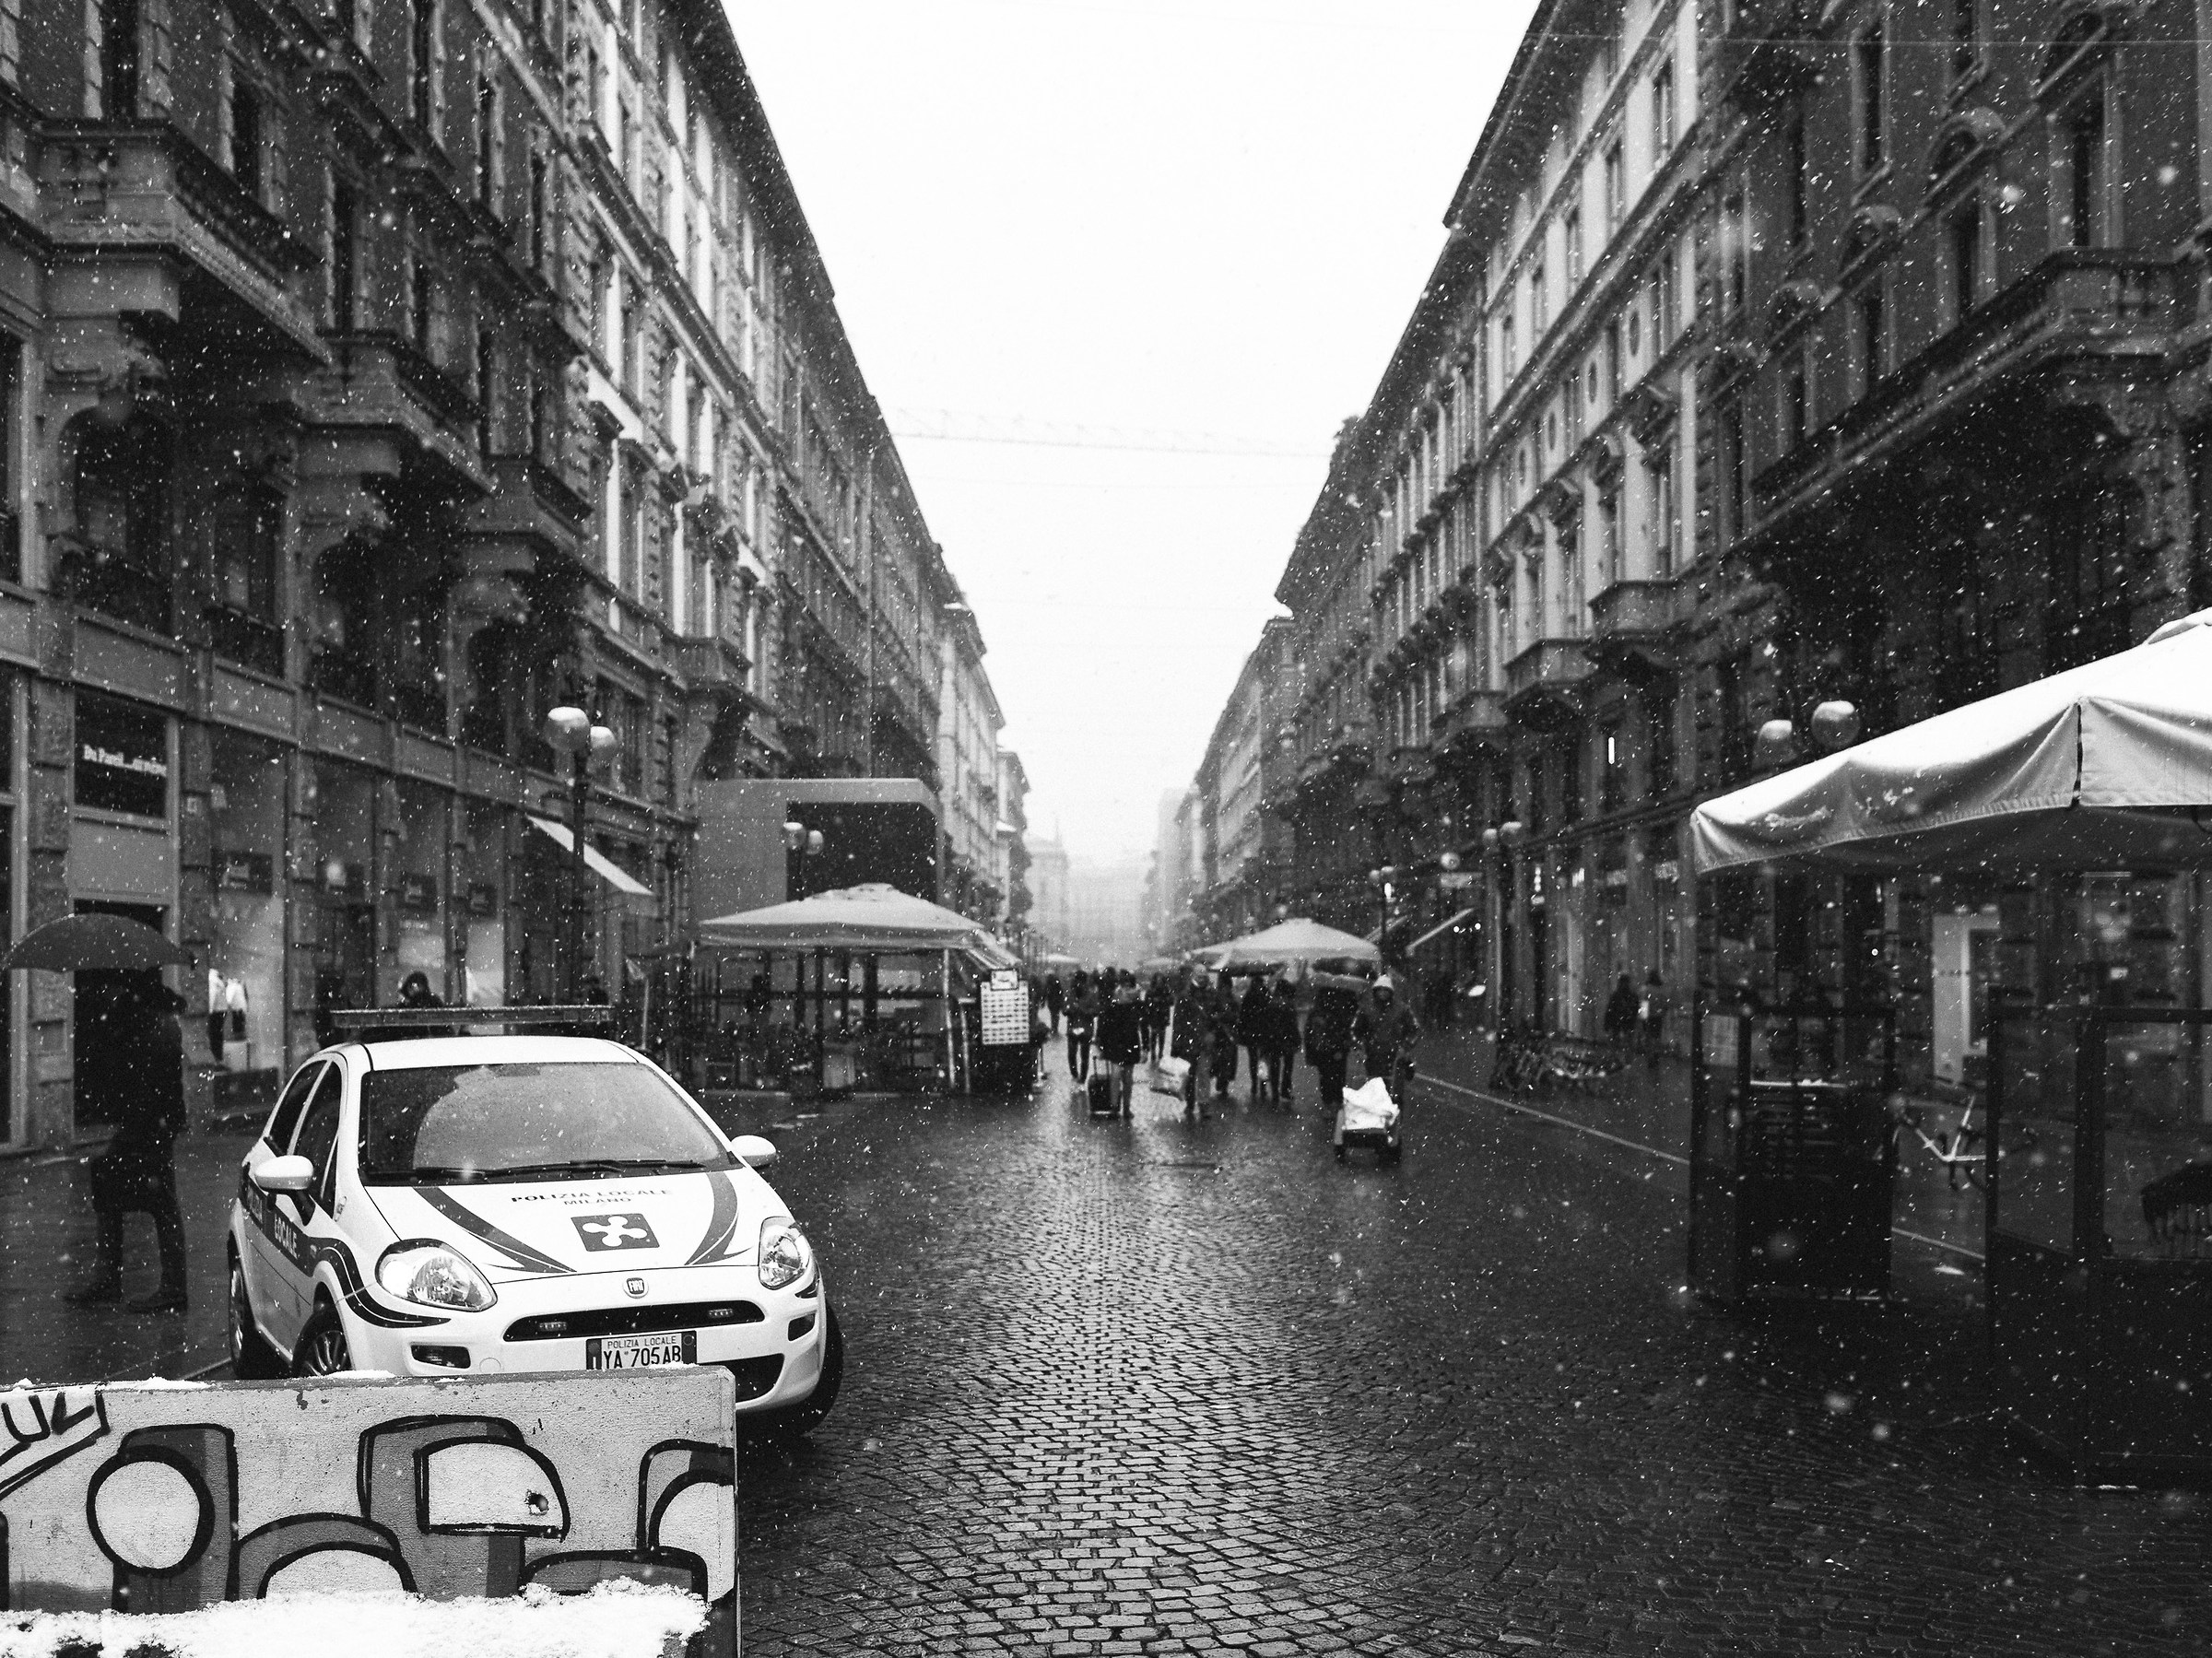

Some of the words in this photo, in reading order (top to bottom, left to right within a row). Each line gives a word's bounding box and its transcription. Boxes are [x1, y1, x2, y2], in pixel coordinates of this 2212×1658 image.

[511, 1193, 591, 1202] POLIZIA
[597, 1189, 674, 1197] LOCALE
[564, 1197, 631, 1205] MILANO
[607, 1339, 640, 1349] POLIZIA
[645, 1335, 677, 1346] LOCALE
